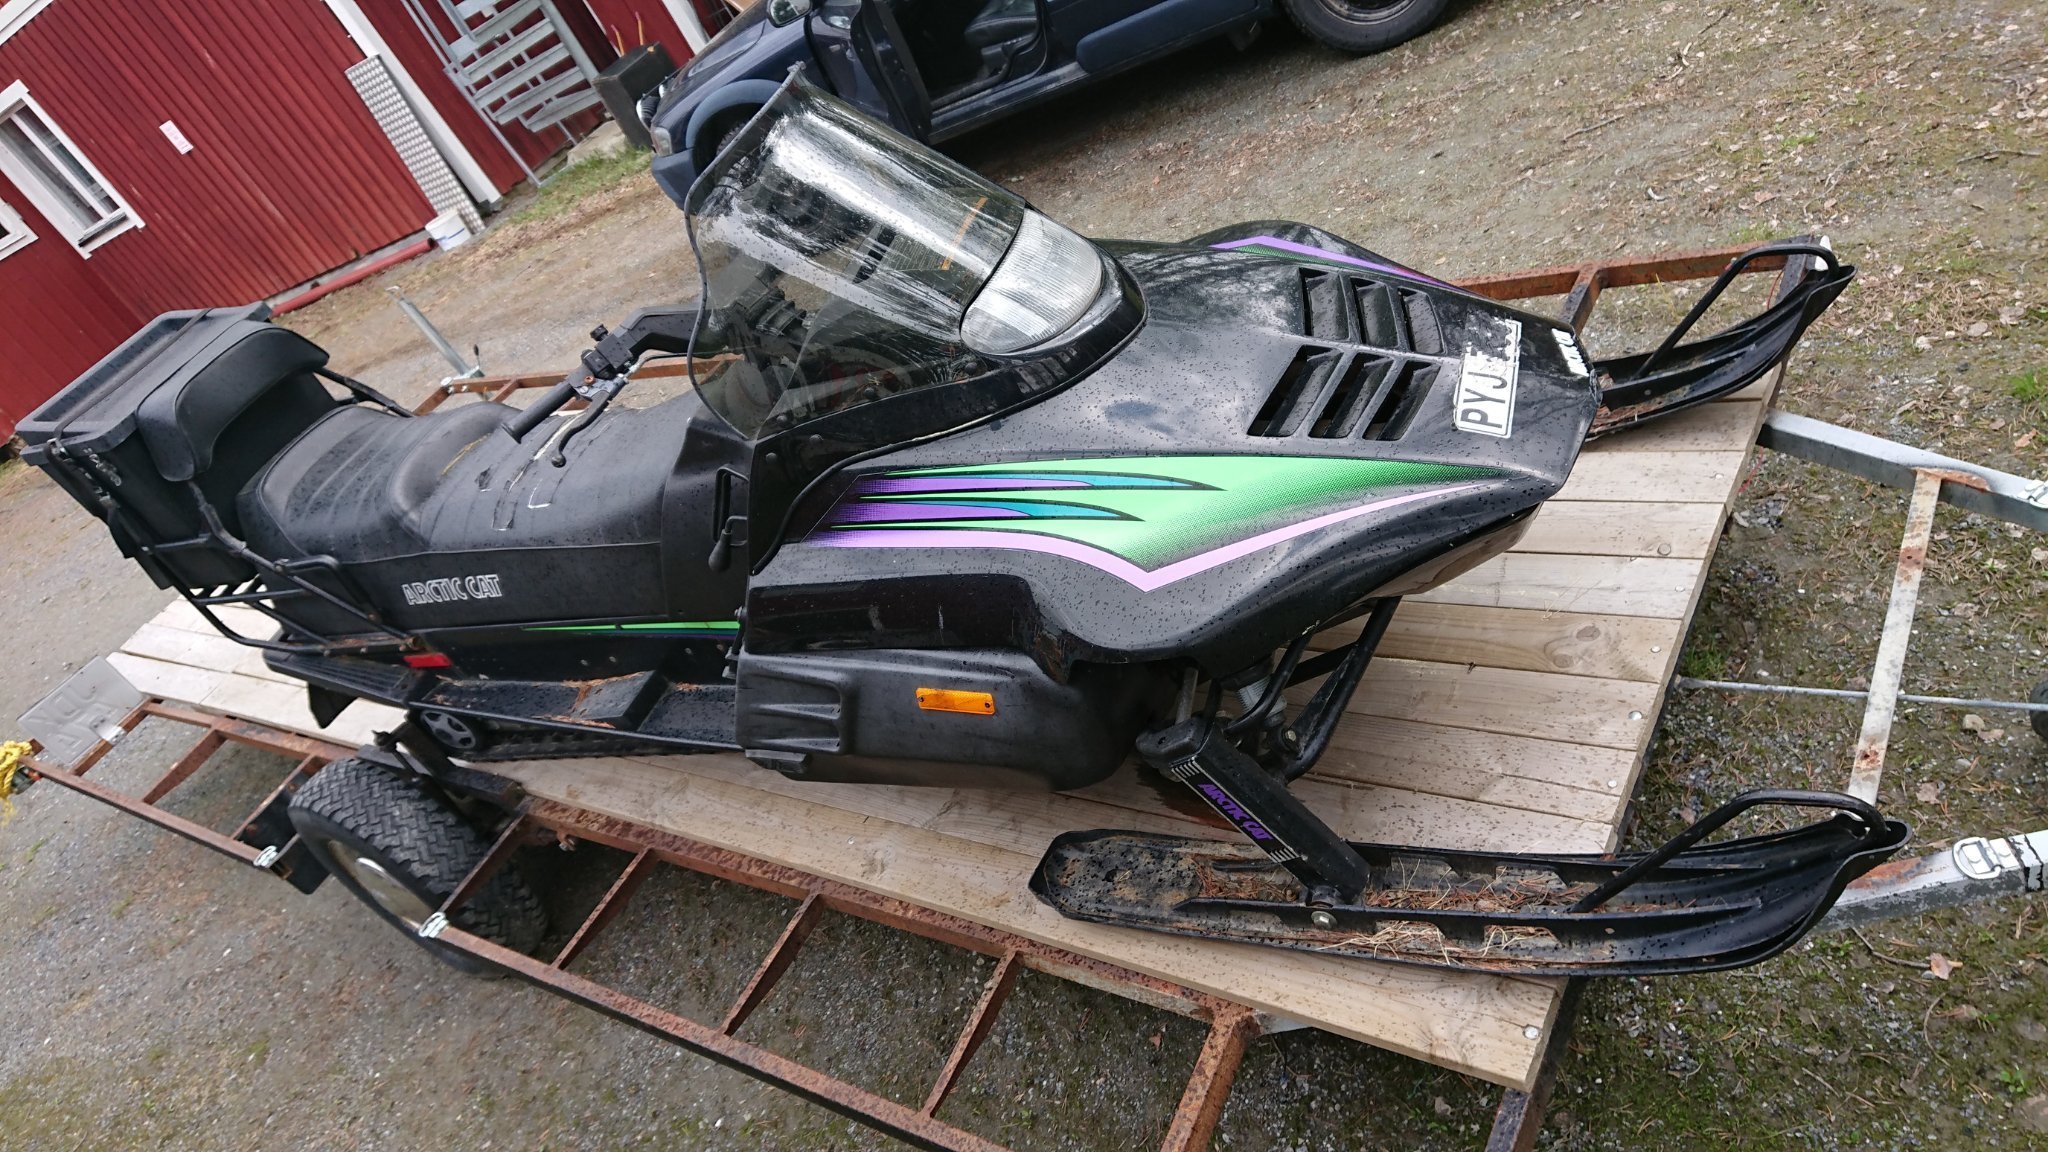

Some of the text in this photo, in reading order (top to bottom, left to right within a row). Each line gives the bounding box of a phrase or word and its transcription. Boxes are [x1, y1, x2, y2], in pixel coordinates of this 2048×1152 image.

[401, 574, 503, 605] ARCTIC CAT
[1197, 783, 1274, 840] ARCTIC CAT
